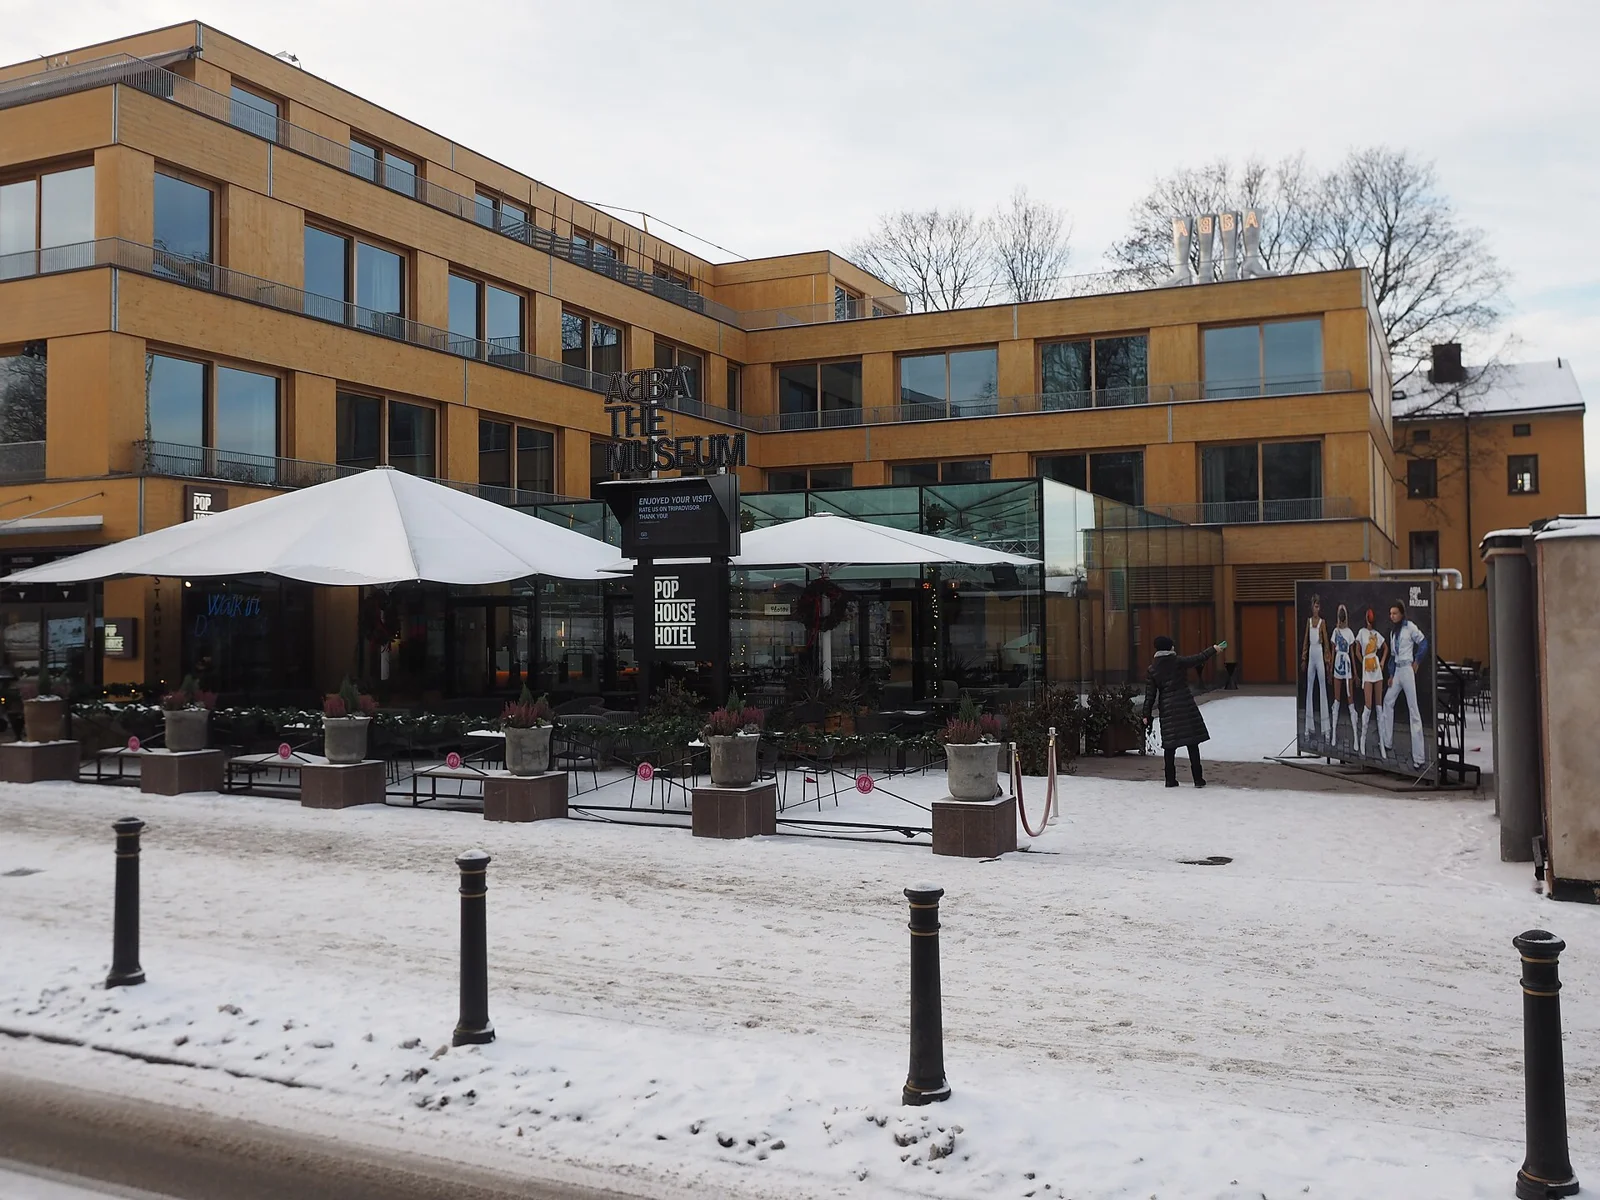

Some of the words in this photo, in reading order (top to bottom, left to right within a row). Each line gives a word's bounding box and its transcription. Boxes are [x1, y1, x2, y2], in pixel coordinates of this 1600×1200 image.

[1178, 211, 1258, 236] ABBA
[604, 365, 692, 404] ABBA
[604, 402, 668, 438] THE
[605, 432, 747, 473] MUSEUM
[193, 496, 212, 510] POP
[639, 497, 669, 505] ENJOYED
[671, 496, 690, 504] YOUR
[692, 495, 712, 503] VISIT?
[655, 580, 679, 599] POP
[655, 603, 696, 622] HOUSE
[655, 626, 695, 645] HOTEL
